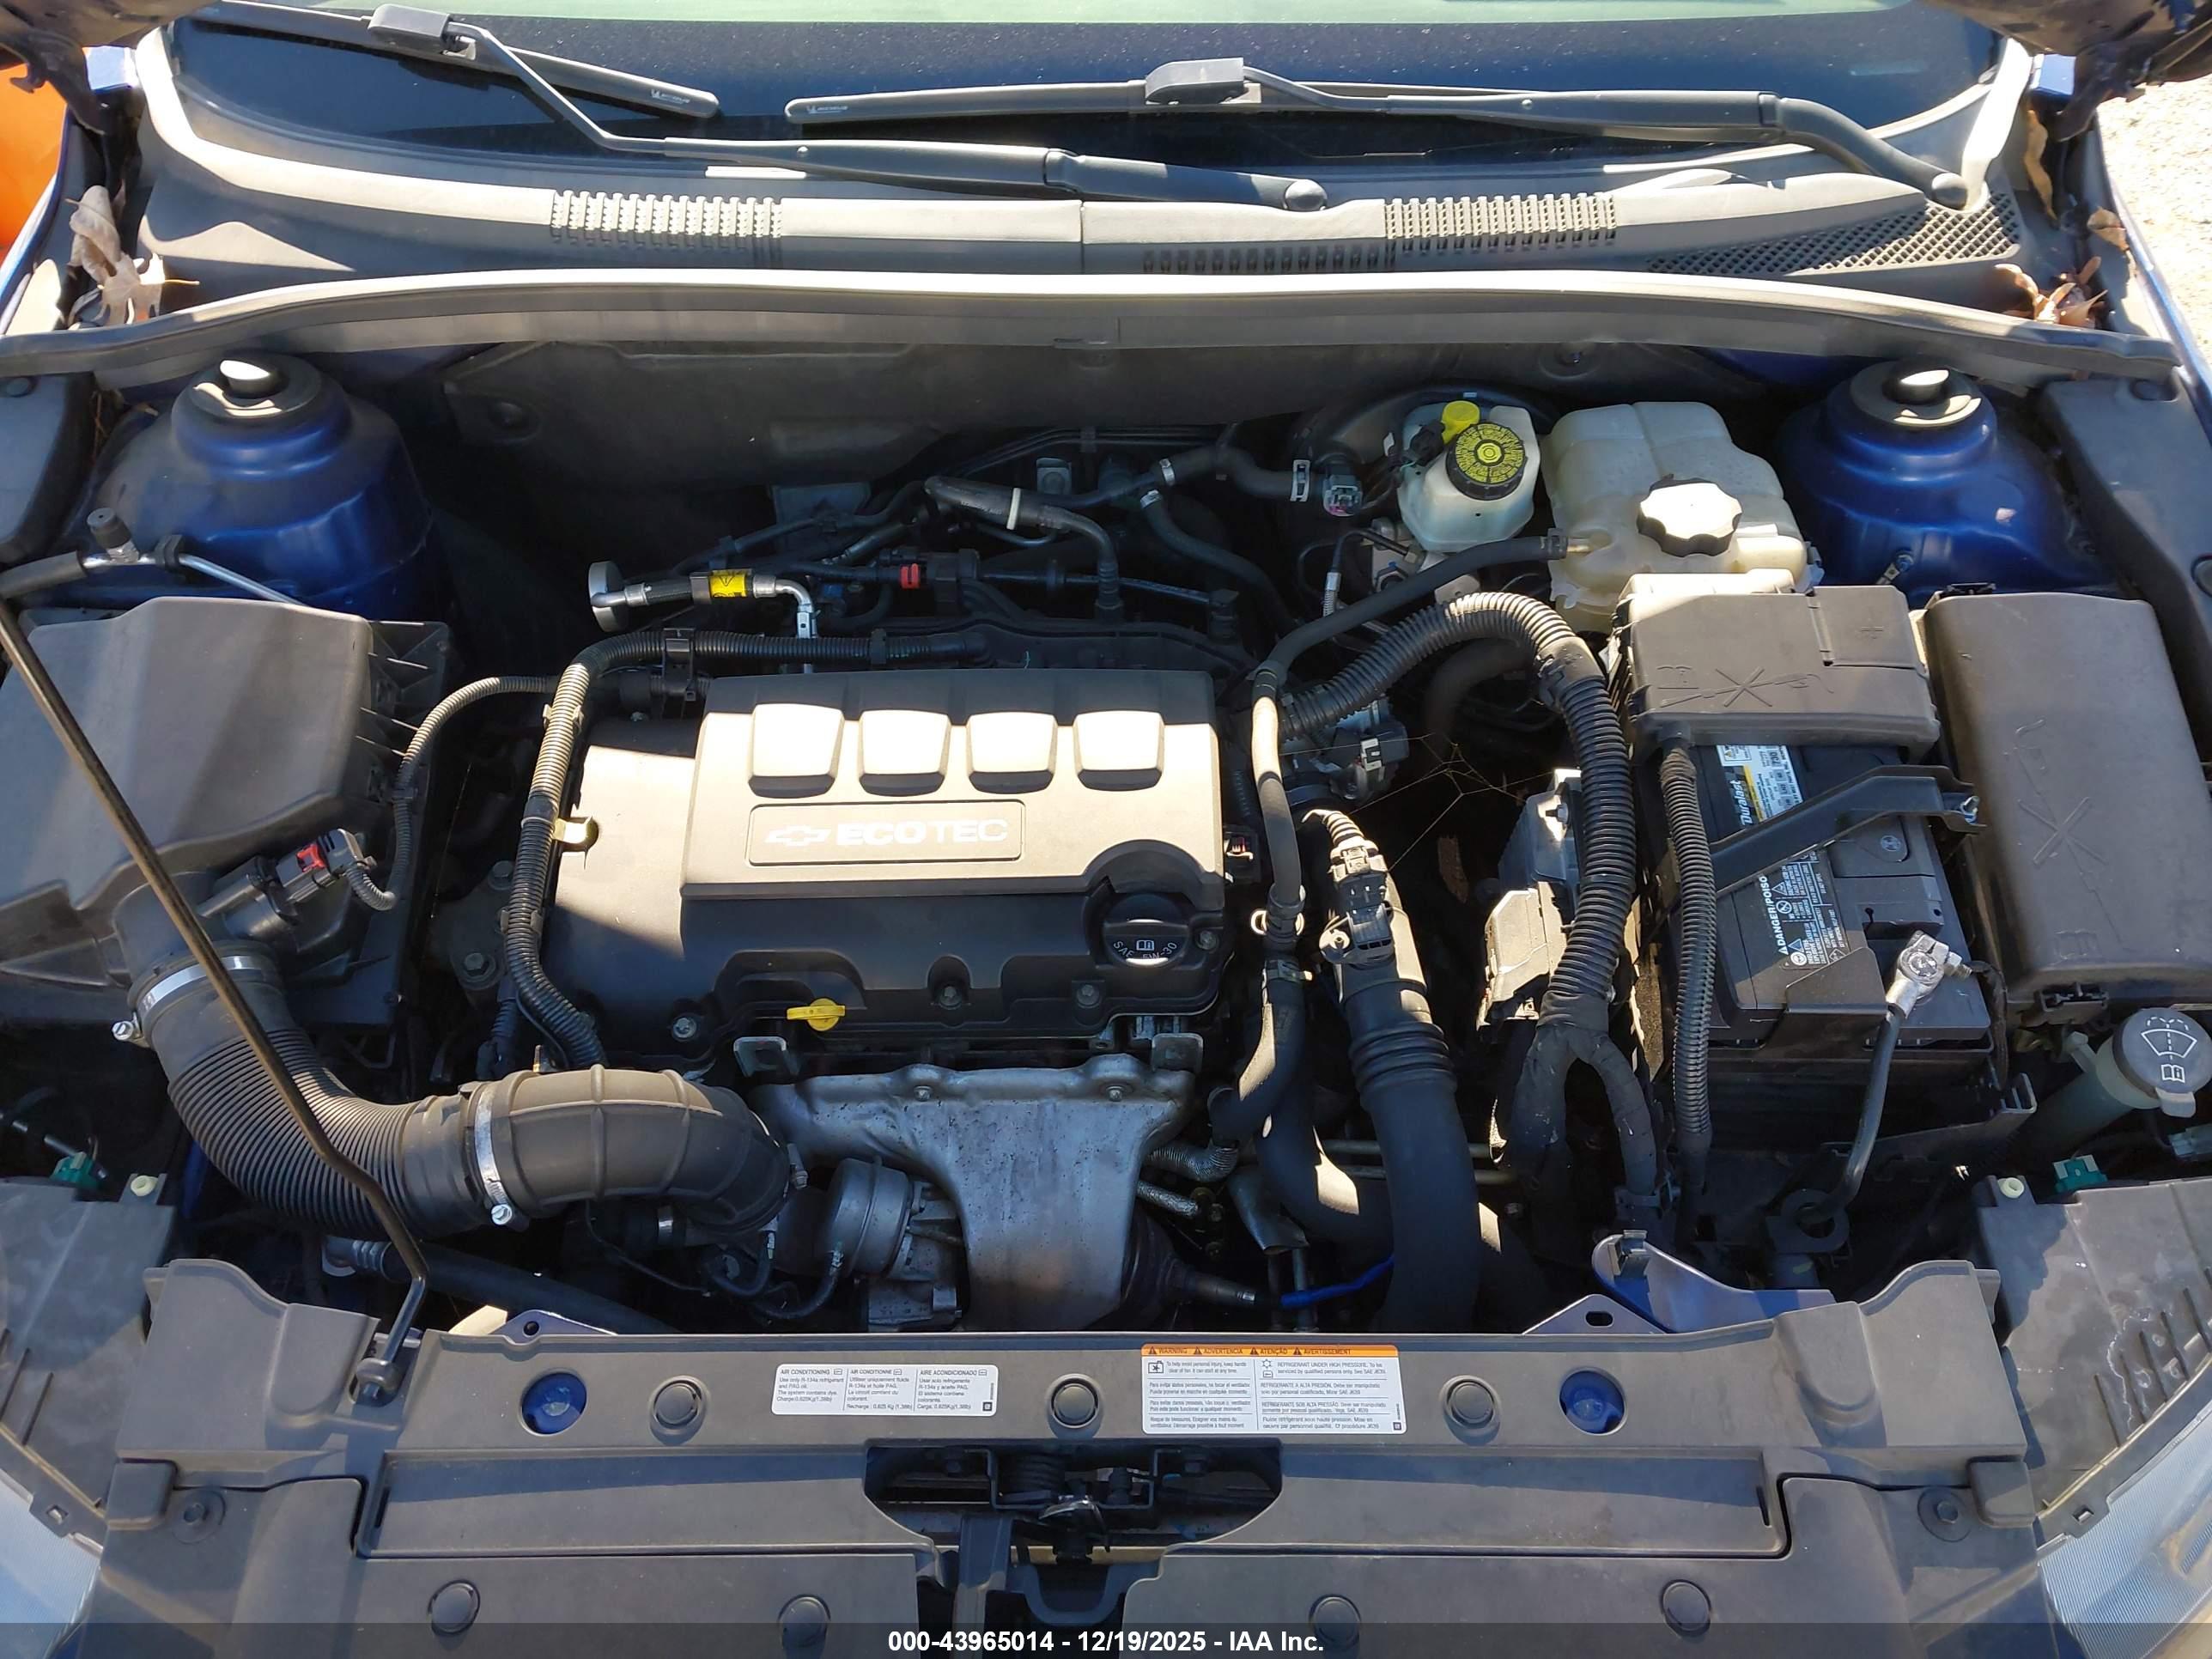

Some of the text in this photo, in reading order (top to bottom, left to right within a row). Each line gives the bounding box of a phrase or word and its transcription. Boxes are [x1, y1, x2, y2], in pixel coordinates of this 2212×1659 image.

[1729, 780, 1753, 825] Duralast
[836, 819, 1009, 846] ECOTEC
[1759, 875, 1787, 945] DANGER/POISO
[1113, 941, 1134, 957] SAE
[1260, 1347, 1288, 1355] ATENÇÃO
